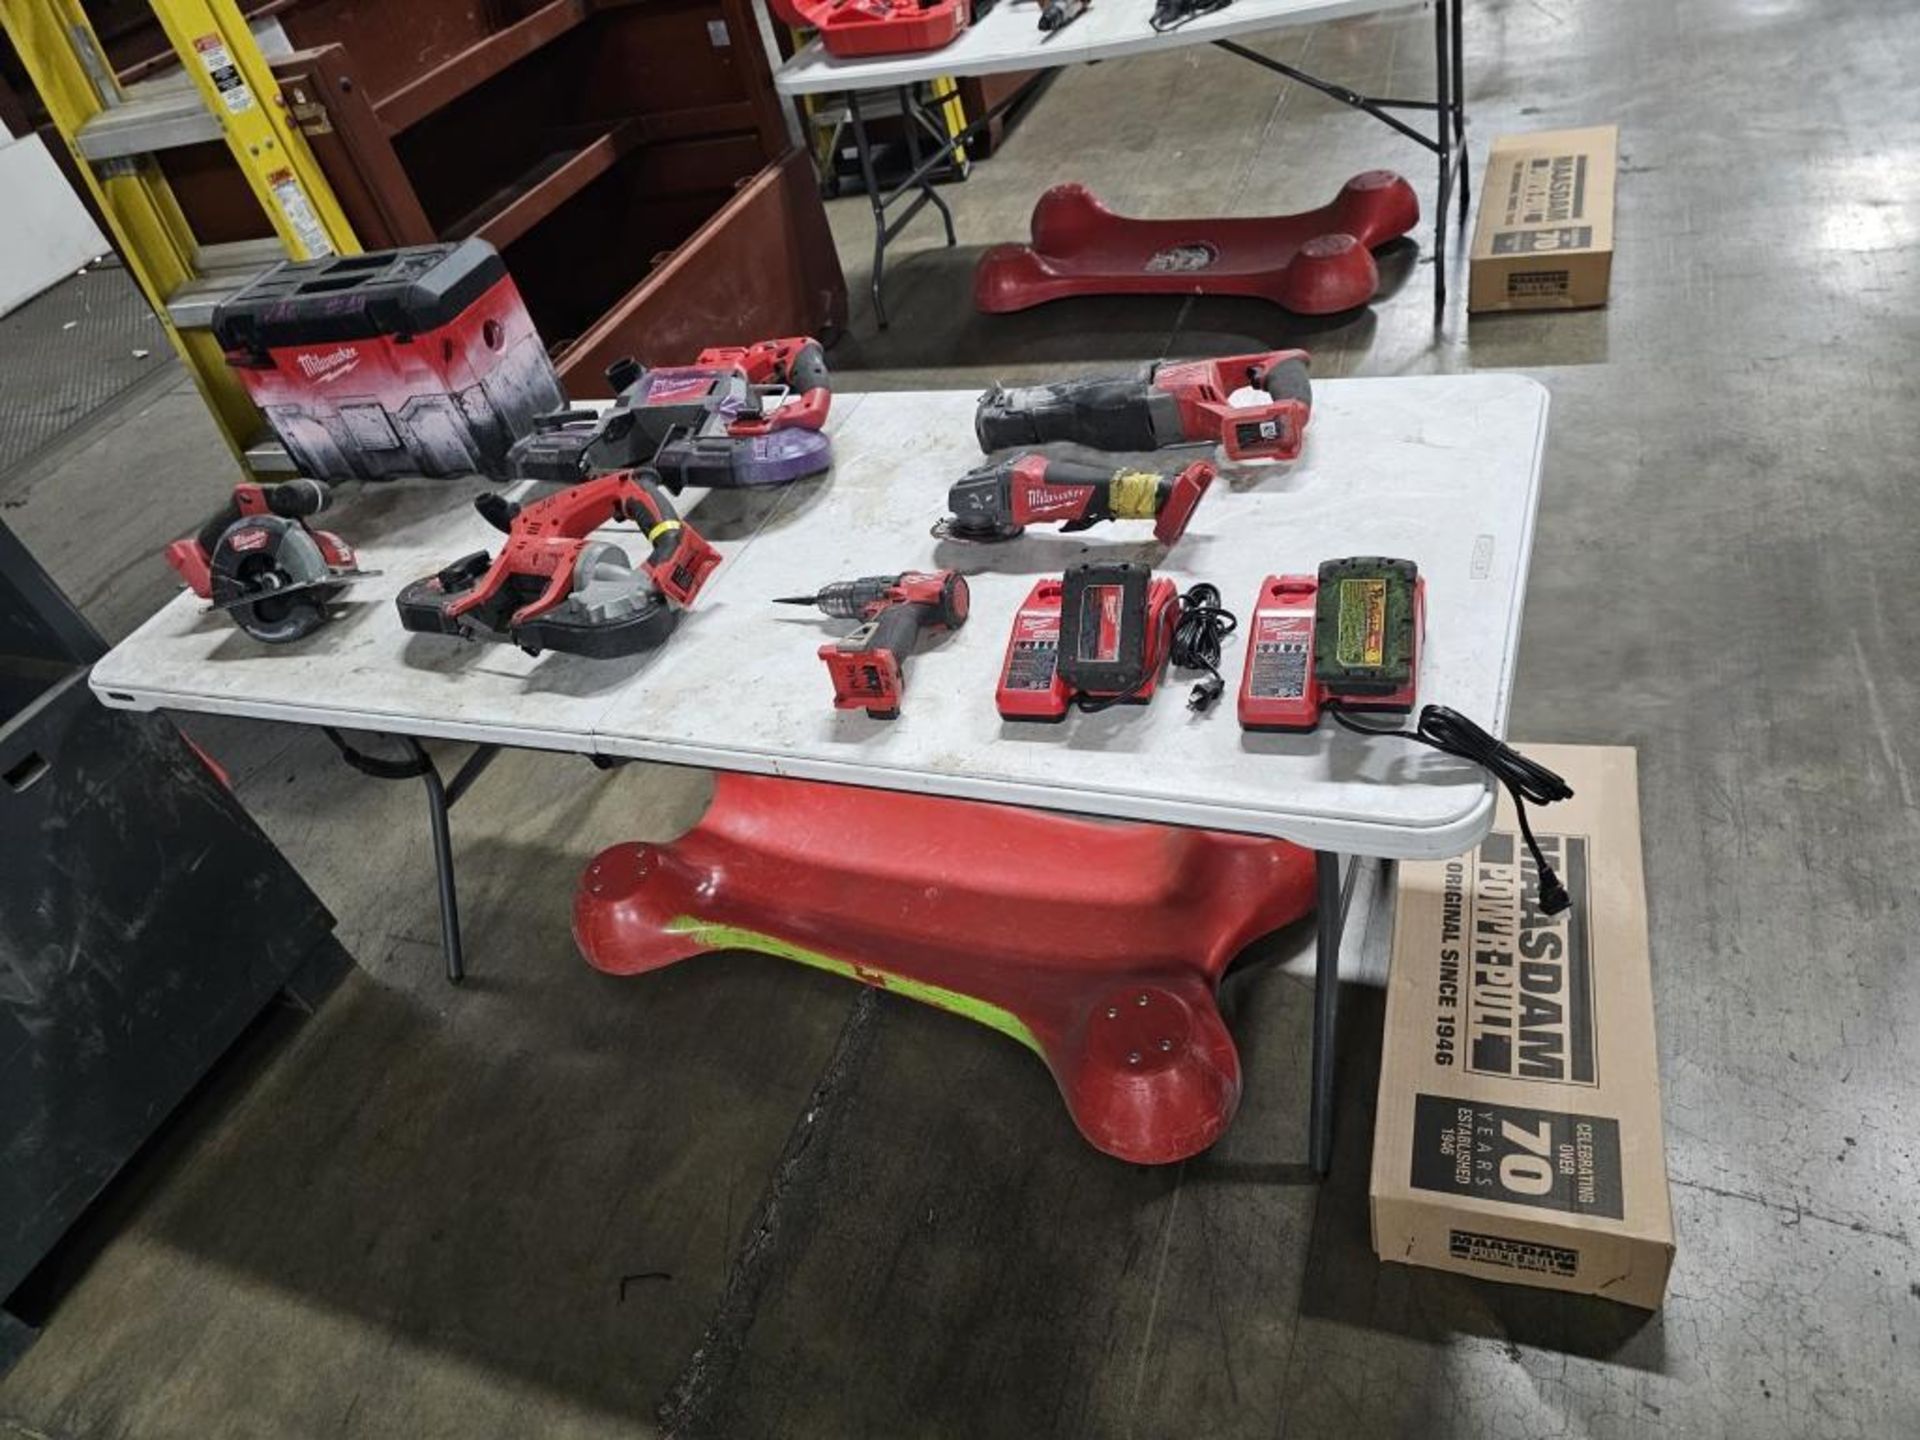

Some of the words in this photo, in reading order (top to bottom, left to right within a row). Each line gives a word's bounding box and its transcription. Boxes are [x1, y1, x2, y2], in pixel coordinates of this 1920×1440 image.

[1442, 863, 1463, 943] ORIGINAL
[1438, 949, 1460, 1008] SINCE
[1435, 1015, 1456, 1066] 1946
[1440, 1128, 1455, 1156] 1946
[1456, 1107, 1473, 1185] ESTABLISHED
[1475, 1111, 1494, 1186] YEARS
[1500, 1120, 1553, 1196] 70
[1560, 1144, 1575, 1175] OVER
[1576, 1122, 1596, 1204] CELEBRATING
